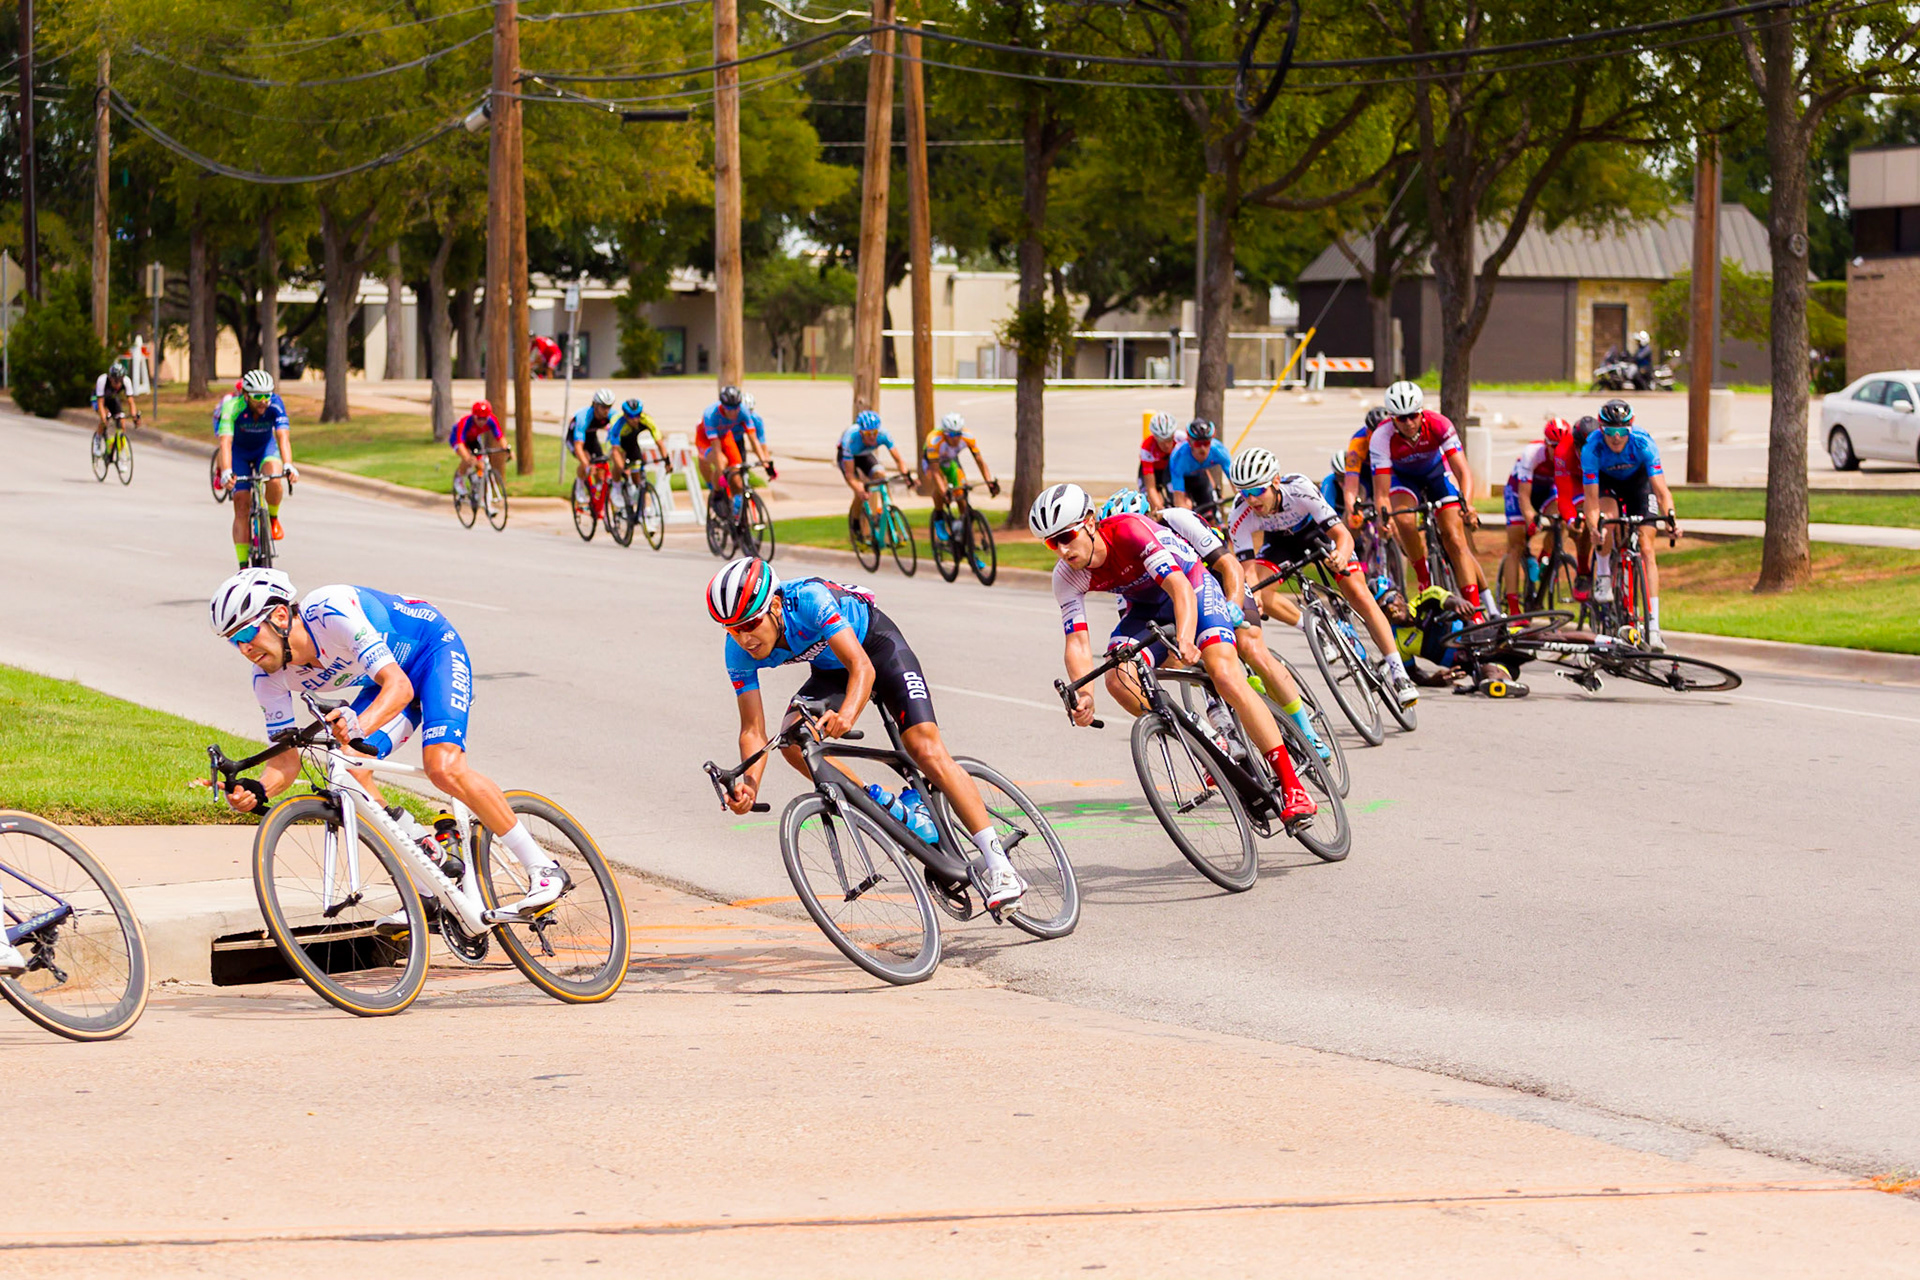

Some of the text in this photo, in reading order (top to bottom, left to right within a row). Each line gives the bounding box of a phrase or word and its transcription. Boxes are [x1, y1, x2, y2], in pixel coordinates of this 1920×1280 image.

[1231, 505, 1253, 536] SRAM
[753, 577, 763, 595] GIRO
[393, 601, 438, 622] SPECIALIZED
[1543, 641, 1589, 653] GIANT
[301, 655, 353, 690] ELBOWZ
[450, 650, 467, 712] ELBOWZ
[903, 671, 928, 699] DBP
